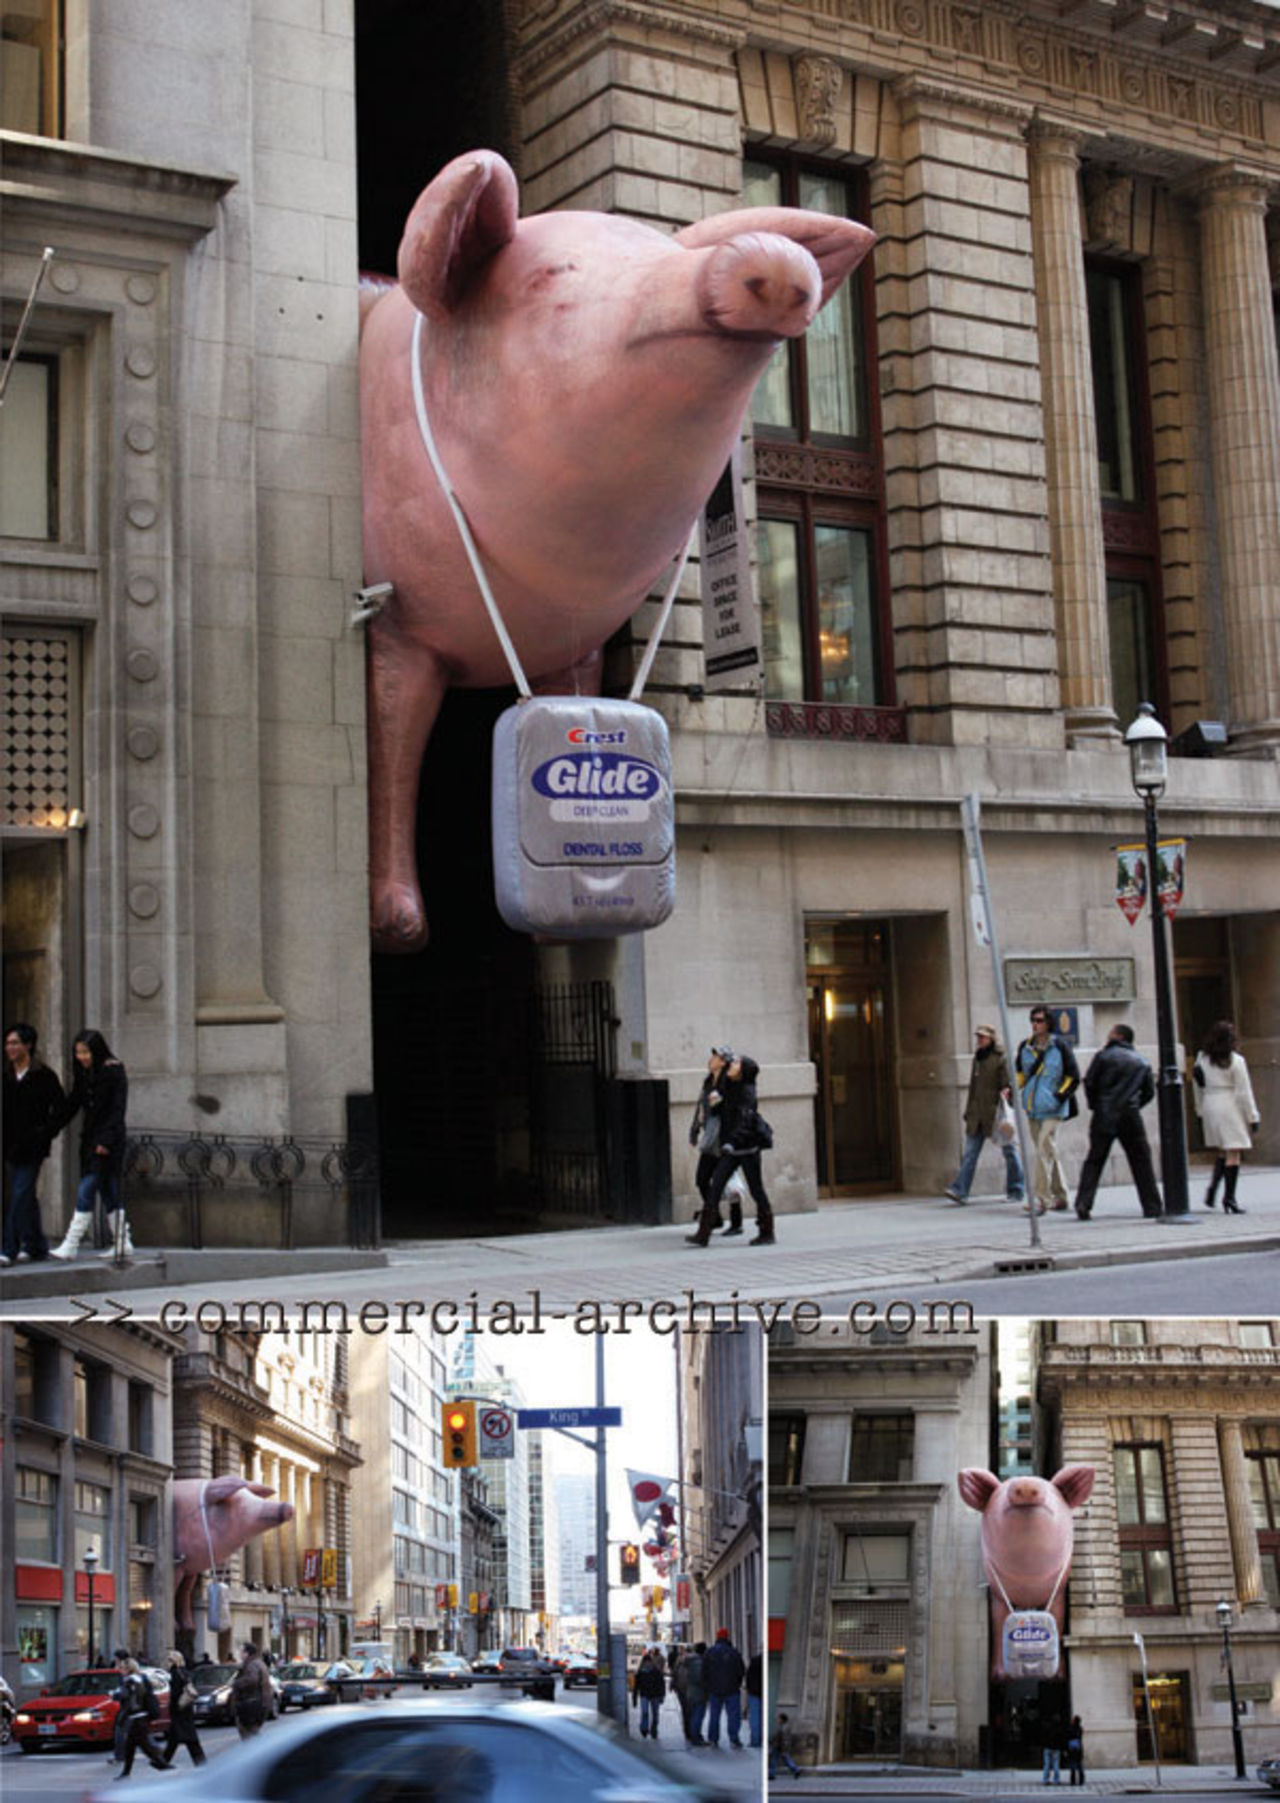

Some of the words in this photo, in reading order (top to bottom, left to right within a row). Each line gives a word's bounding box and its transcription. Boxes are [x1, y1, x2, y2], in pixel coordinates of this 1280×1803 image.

[711, 574, 737, 592] OFFICE
[715, 622, 740, 639] LEASE
[568, 728, 626, 744] Crest
[547, 758, 650, 795] Glide
[599, 805, 629, 817] CLEAN
[563, 842, 607, 857] DENTAL
[609, 842, 643, 857] FLOSS
[549, 1409, 579, 1427] King
